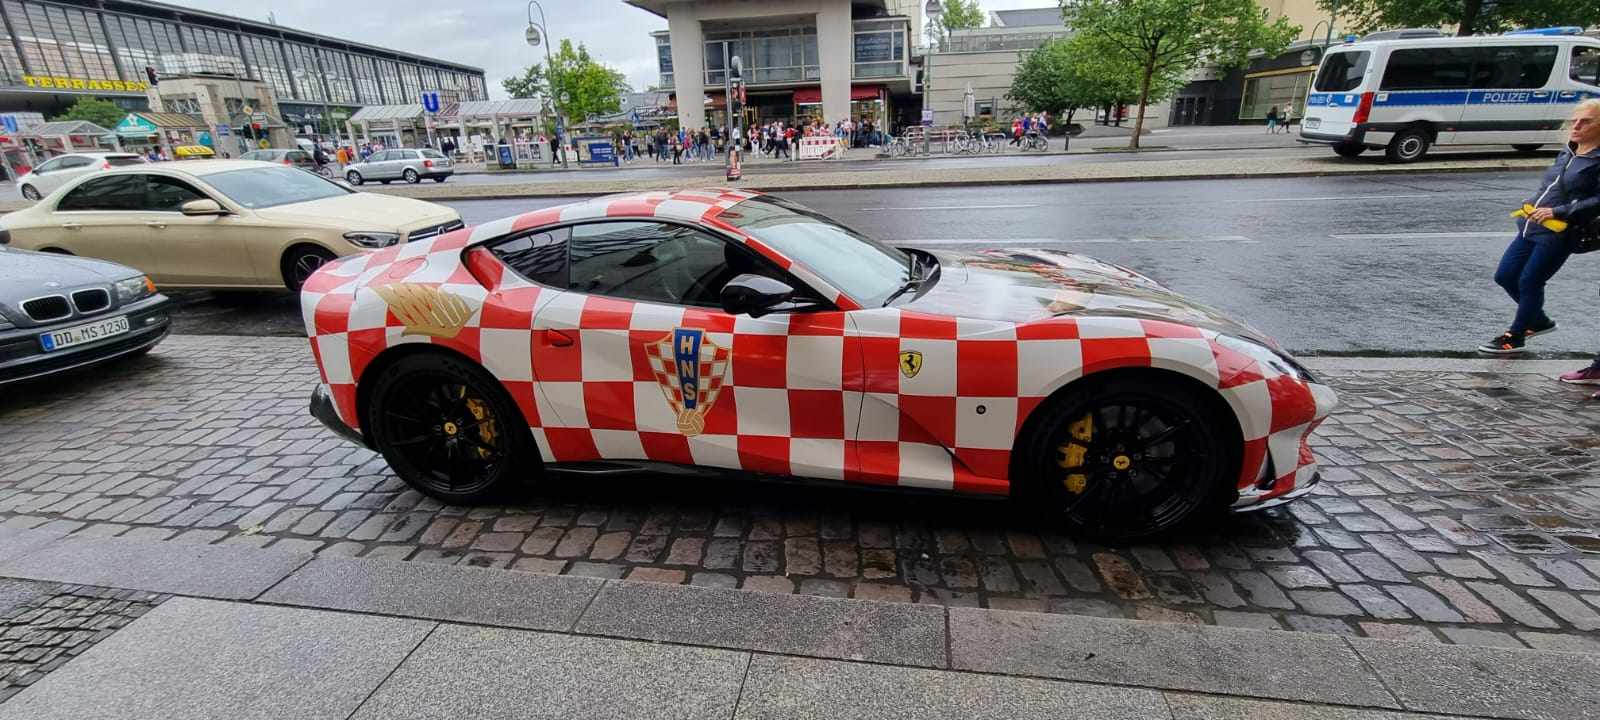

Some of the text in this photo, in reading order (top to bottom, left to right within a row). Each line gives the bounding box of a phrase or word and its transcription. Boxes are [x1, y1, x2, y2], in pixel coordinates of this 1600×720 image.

[23, 74, 146, 92] TERRASSEN
[422, 93, 439, 113] U
[1482, 92, 1531, 103] POLIZEI
[54, 318, 128, 346] DD MS 1230
[680, 335, 696, 401] HNS
